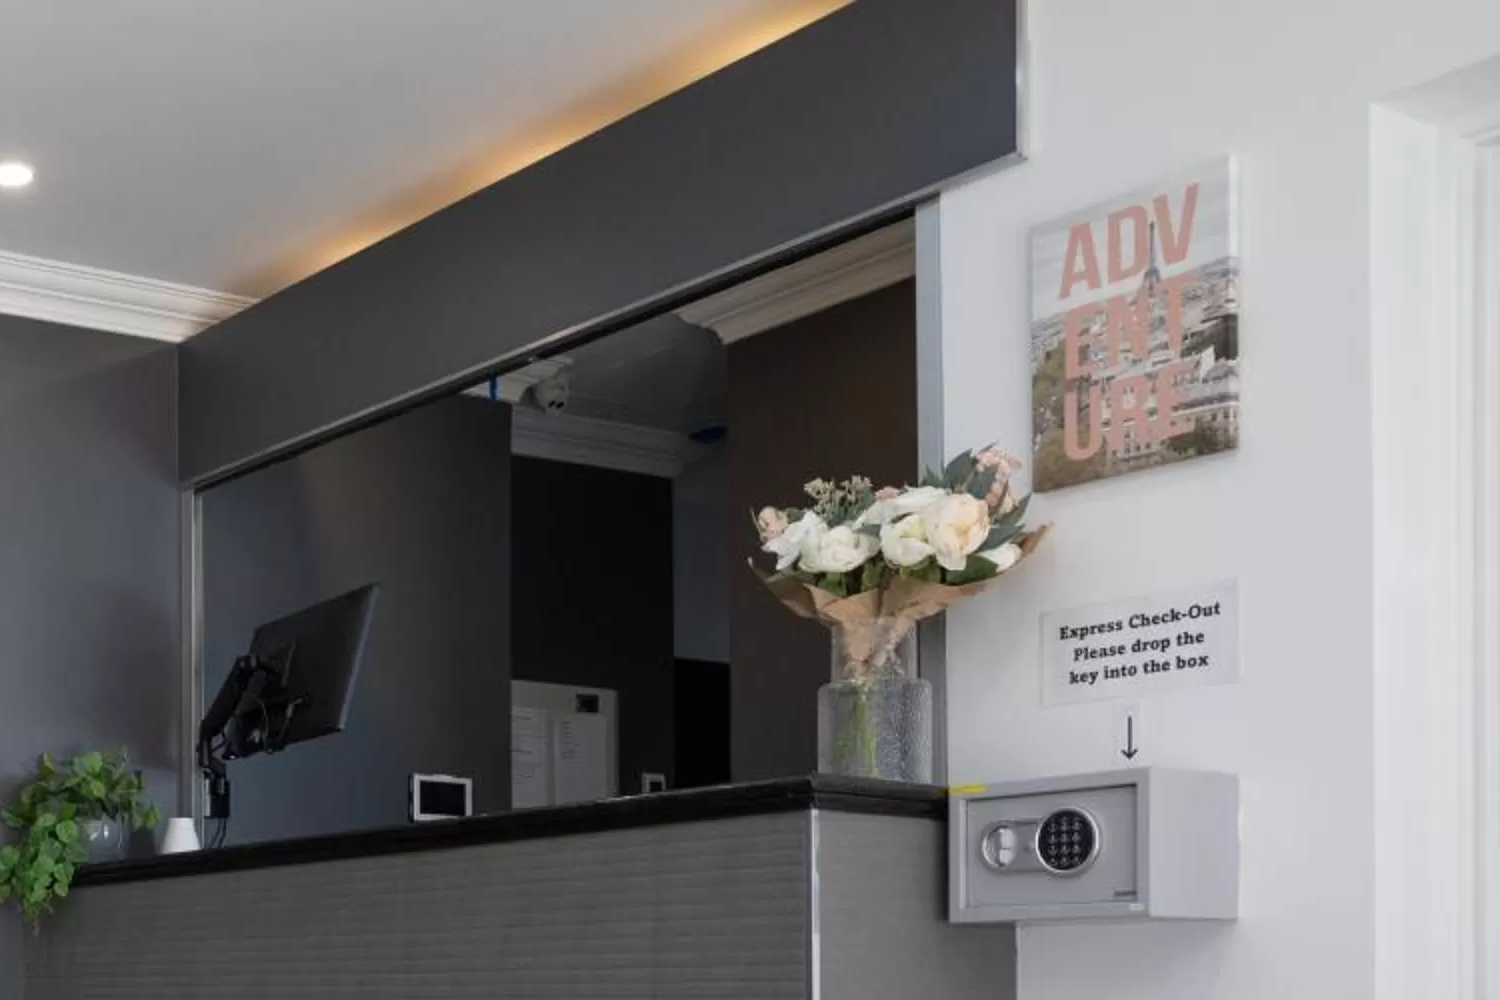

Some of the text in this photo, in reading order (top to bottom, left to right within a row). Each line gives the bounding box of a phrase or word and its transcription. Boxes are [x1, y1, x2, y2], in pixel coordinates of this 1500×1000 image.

[1059, 182, 1199, 299] ADV
[1064, 275, 1194, 380] ENT
[1064, 360, 1196, 461] URE
[1059, 601, 1221, 641] Express Check-Out
[1073, 630, 1205, 662] Please drop the
[1069, 655, 1209, 685] key into the box
